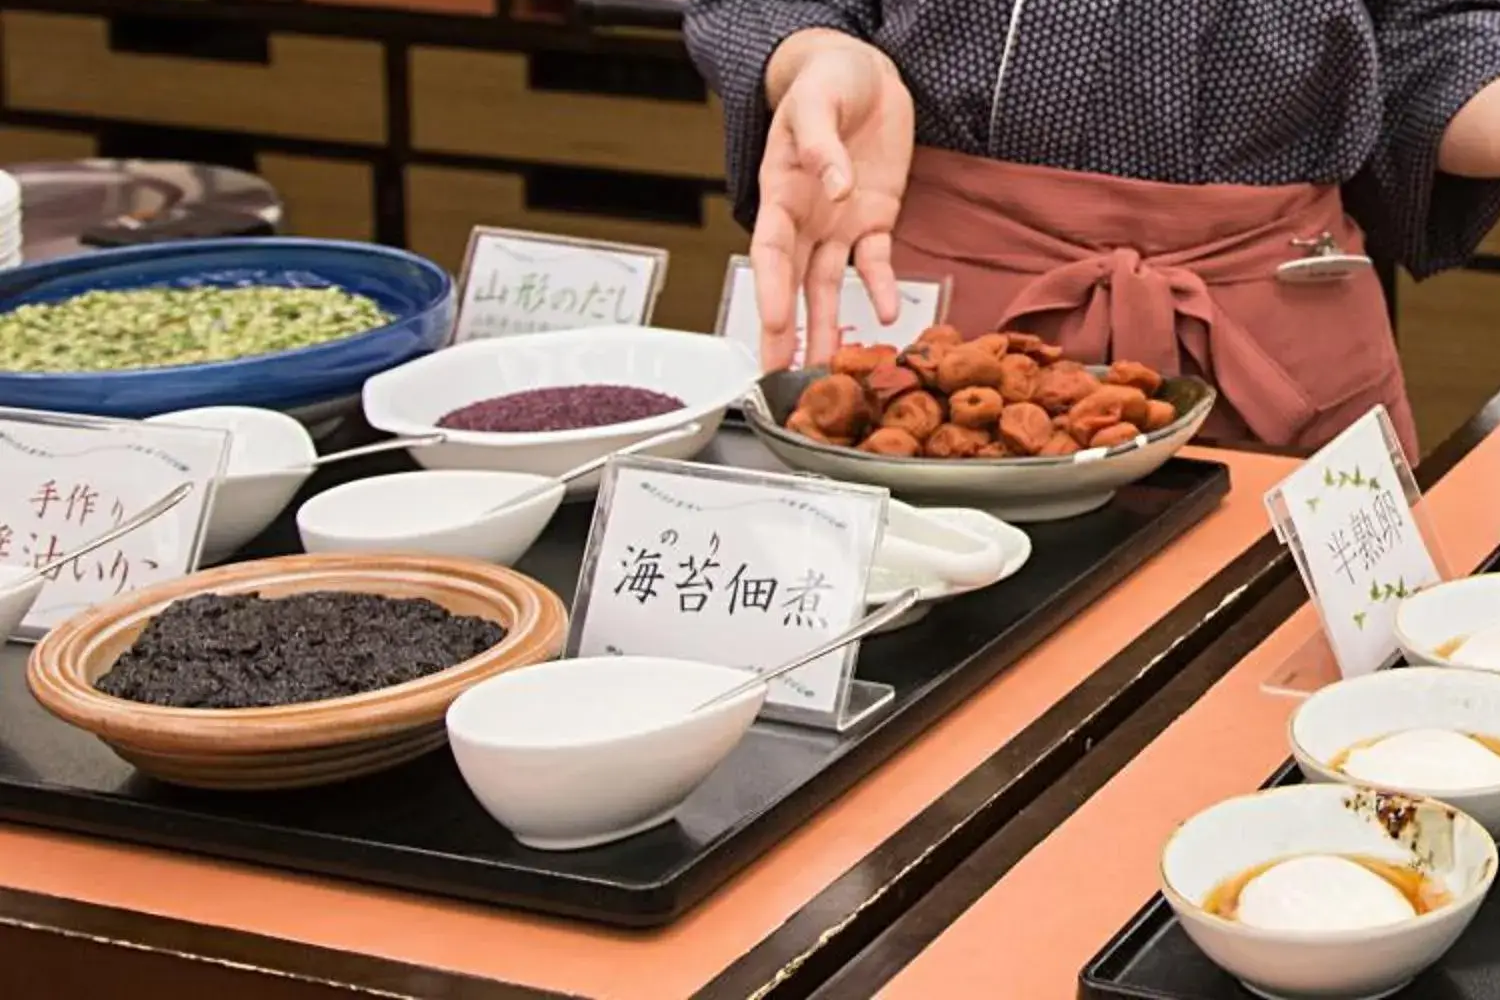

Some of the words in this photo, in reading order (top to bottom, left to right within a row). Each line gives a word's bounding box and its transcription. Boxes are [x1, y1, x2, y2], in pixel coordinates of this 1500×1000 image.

[29, 479, 125, 528] 手作り
[1327, 489, 1404, 585] 半熟卵
[659, 528, 721, 556] のり
[613, 544, 834, 629] 海苔佃煮
